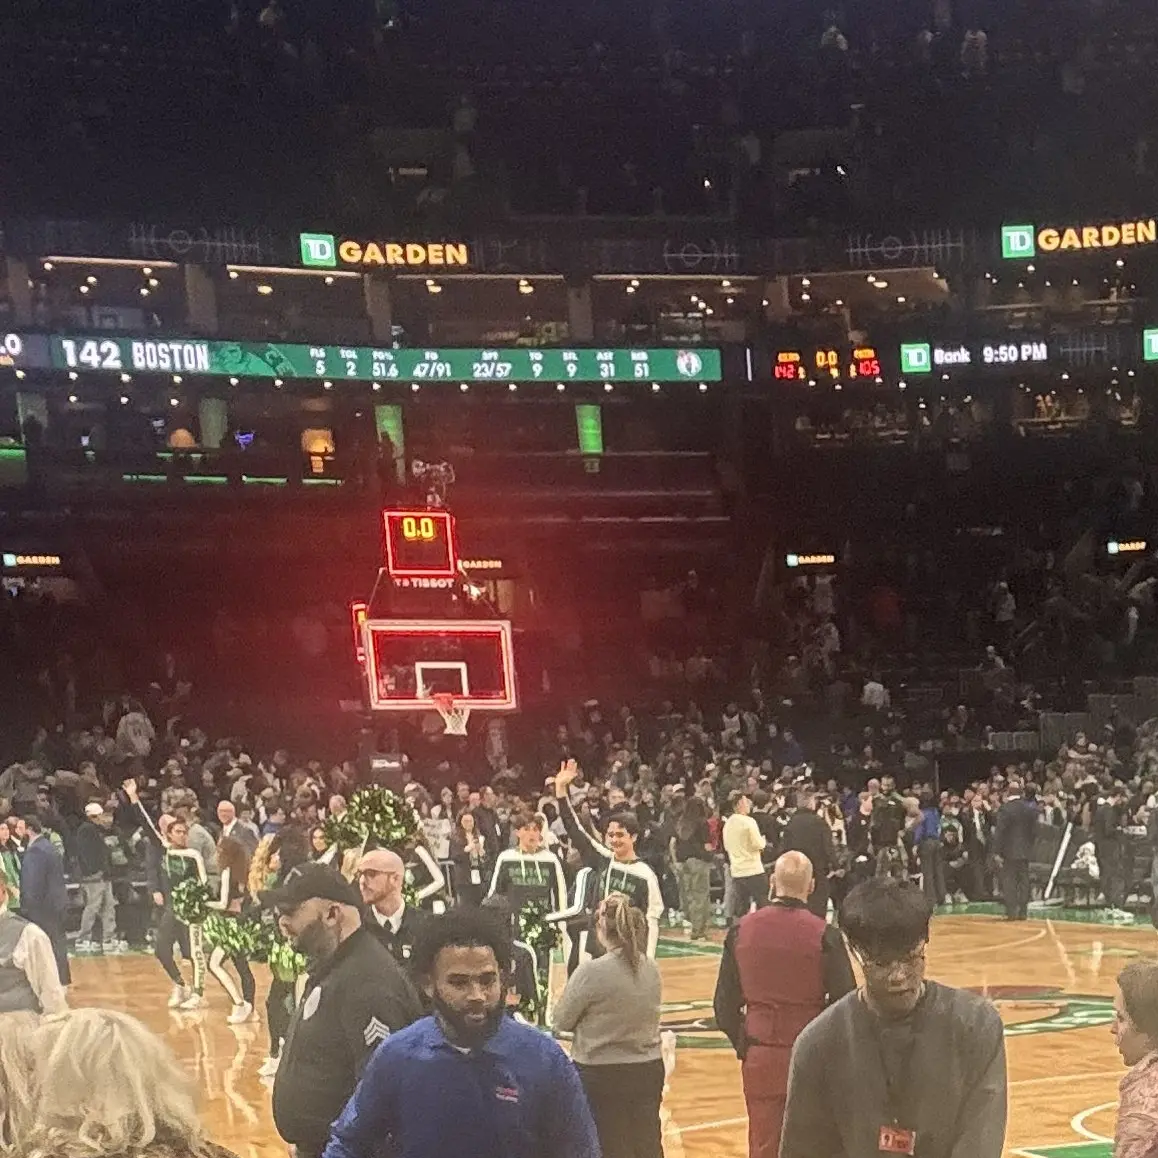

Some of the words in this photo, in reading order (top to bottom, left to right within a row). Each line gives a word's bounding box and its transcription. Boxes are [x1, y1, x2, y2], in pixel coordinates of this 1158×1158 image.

[1037, 220, 1157, 251] GARDEN
[339, 241, 468, 264] GARDEN
[62, 339, 121, 369] 142
[132, 341, 209, 370] BOSTON
[934, 348, 970, 363] Bank
[983, 346, 1018, 362] 9:50
[1021, 343, 1047, 361] PM
[346, 361, 357, 376] 2
[413, 362, 451, 377] 47/91
[472, 362, 512, 378] 23/57
[532, 362, 543, 378] 9
[567, 362, 578, 378] 9
[600, 362, 615, 377] 31
[634, 362, 649, 377] 51
[403, 517, 434, 539] 0.0
